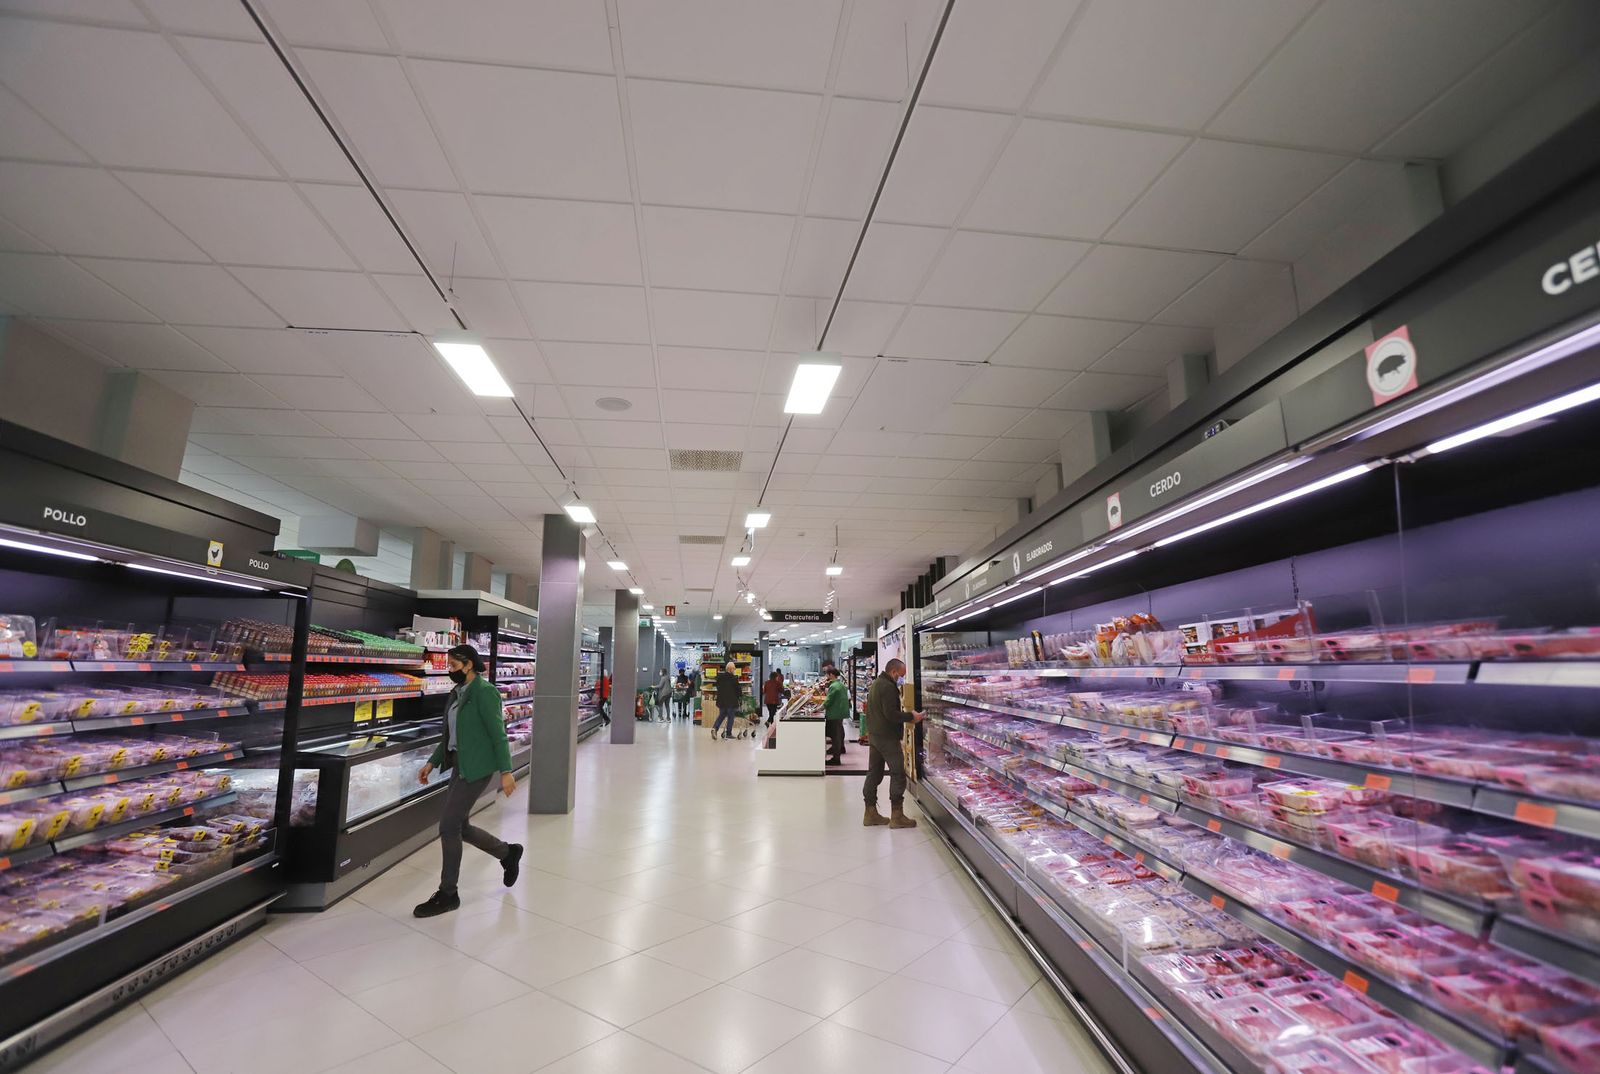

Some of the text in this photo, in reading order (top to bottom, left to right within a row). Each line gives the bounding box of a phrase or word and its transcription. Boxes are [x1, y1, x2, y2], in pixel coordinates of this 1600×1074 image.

[1542, 240, 1600, 295] CE
[1150, 471, 1181, 497] CERDO
[44, 506, 87, 526] POLLO
[1026, 541, 1053, 561] ELABORADOS
[249, 558, 270, 570] POLLO
